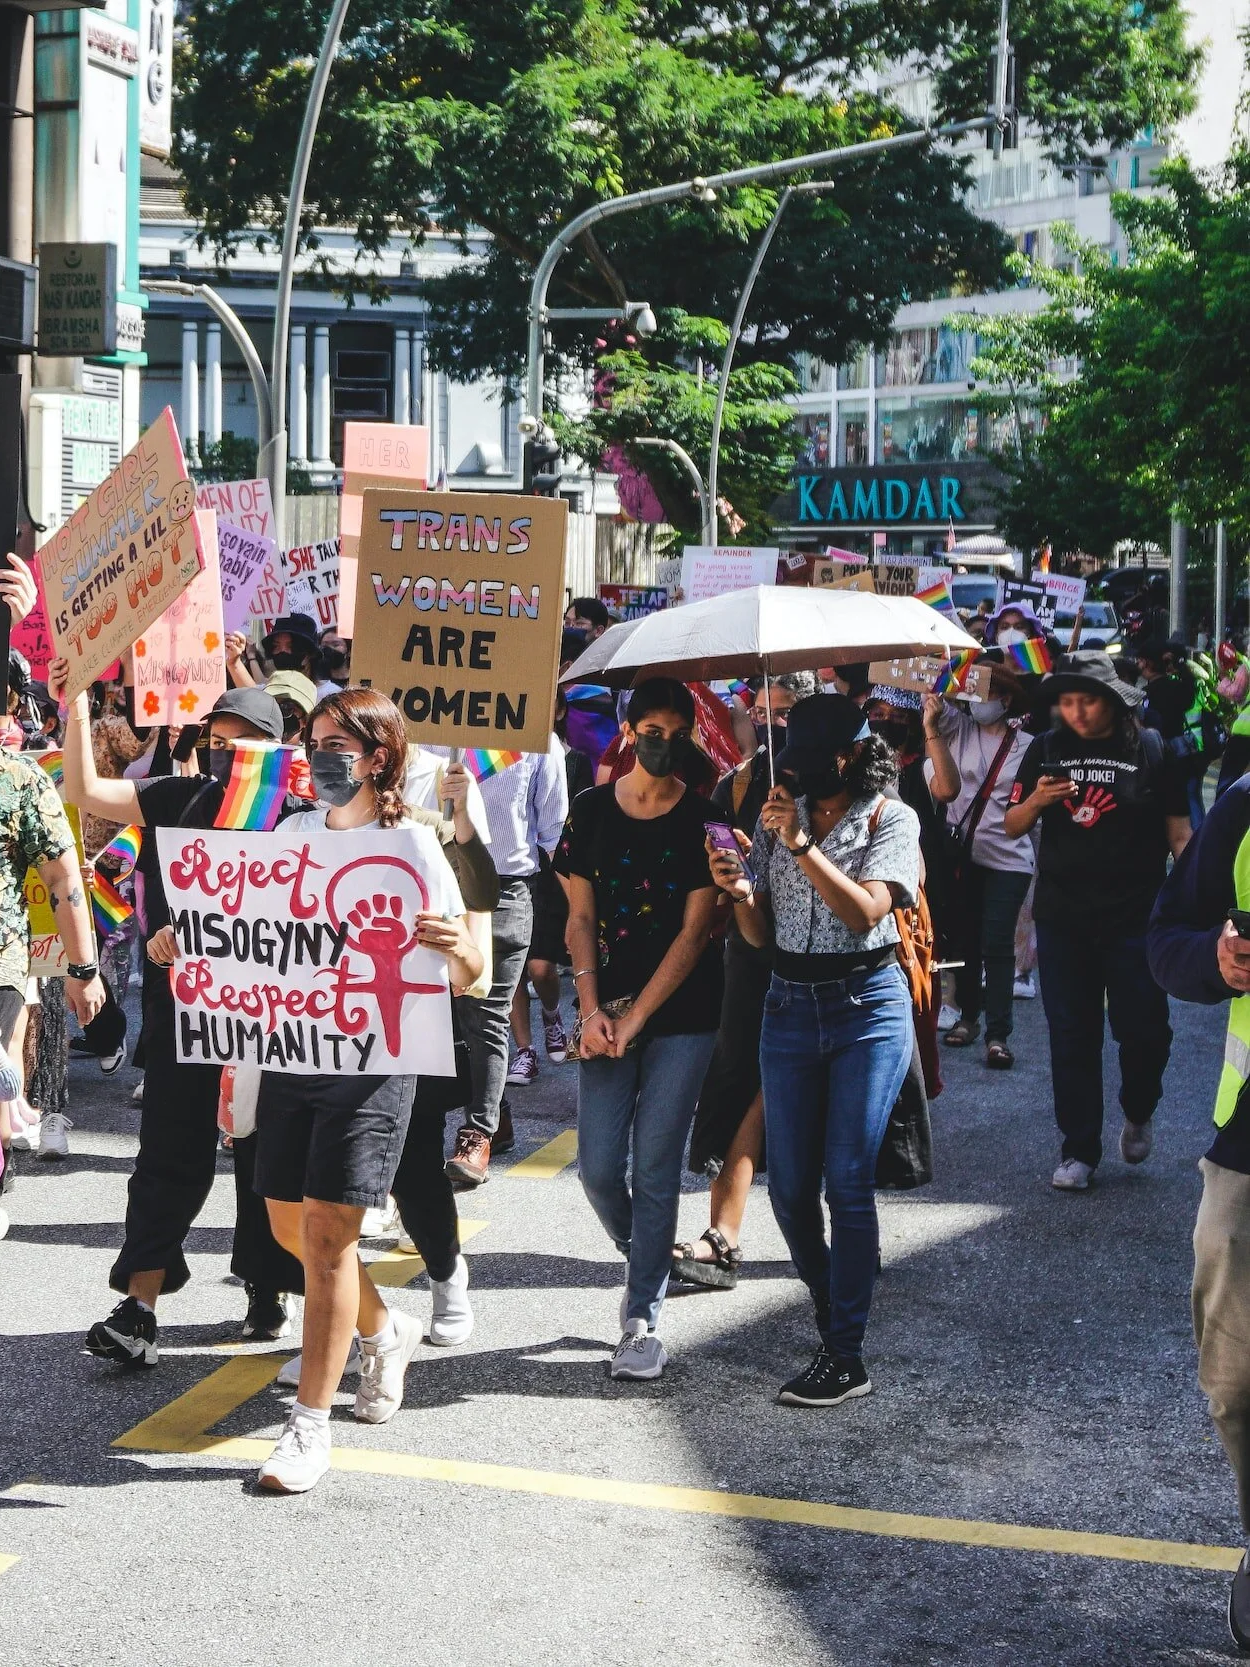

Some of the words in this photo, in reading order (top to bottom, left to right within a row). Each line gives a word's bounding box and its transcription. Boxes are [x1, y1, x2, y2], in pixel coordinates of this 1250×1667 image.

[63, 399, 119, 438] TEXTILE
[360, 437, 411, 469] HER
[39, 502, 89, 581] HOT
[97, 440, 158, 518] GIRL
[238, 481, 265, 512] OF
[798, 475, 966, 521] KAMDAR
[61, 471, 166, 601] SUMMER
[239, 539, 267, 564] vain
[379, 509, 532, 554] TRANS
[713, 549, 752, 557] REMINDER
[55, 610, 69, 635] IS
[71, 554, 125, 617] GETTING
[129, 542, 138, 563] A
[143, 516, 166, 549] LIL
[289, 546, 317, 577] SHE
[886, 566, 914, 582] YOUR
[67, 592, 118, 656] TOO
[125, 524, 185, 609] HOT
[371, 573, 540, 619] WOMEN
[619, 589, 667, 606] TETAP
[101, 619, 134, 658] CLIMATE
[136, 572, 181, 622] EMERGENCY
[401, 624, 496, 669] ARE
[138, 656, 223, 687] MISOGYNIST
[1070, 769, 1084, 781] NO
[1086, 769, 1115, 783] JOKE!
[1083, 759, 1138, 773] HARASSMENT
[170, 838, 327, 919] Reject
[169, 907, 349, 976] MISOGYNY
[175, 955, 369, 1036] Respect
[180, 1011, 376, 1071] HUMANITY
